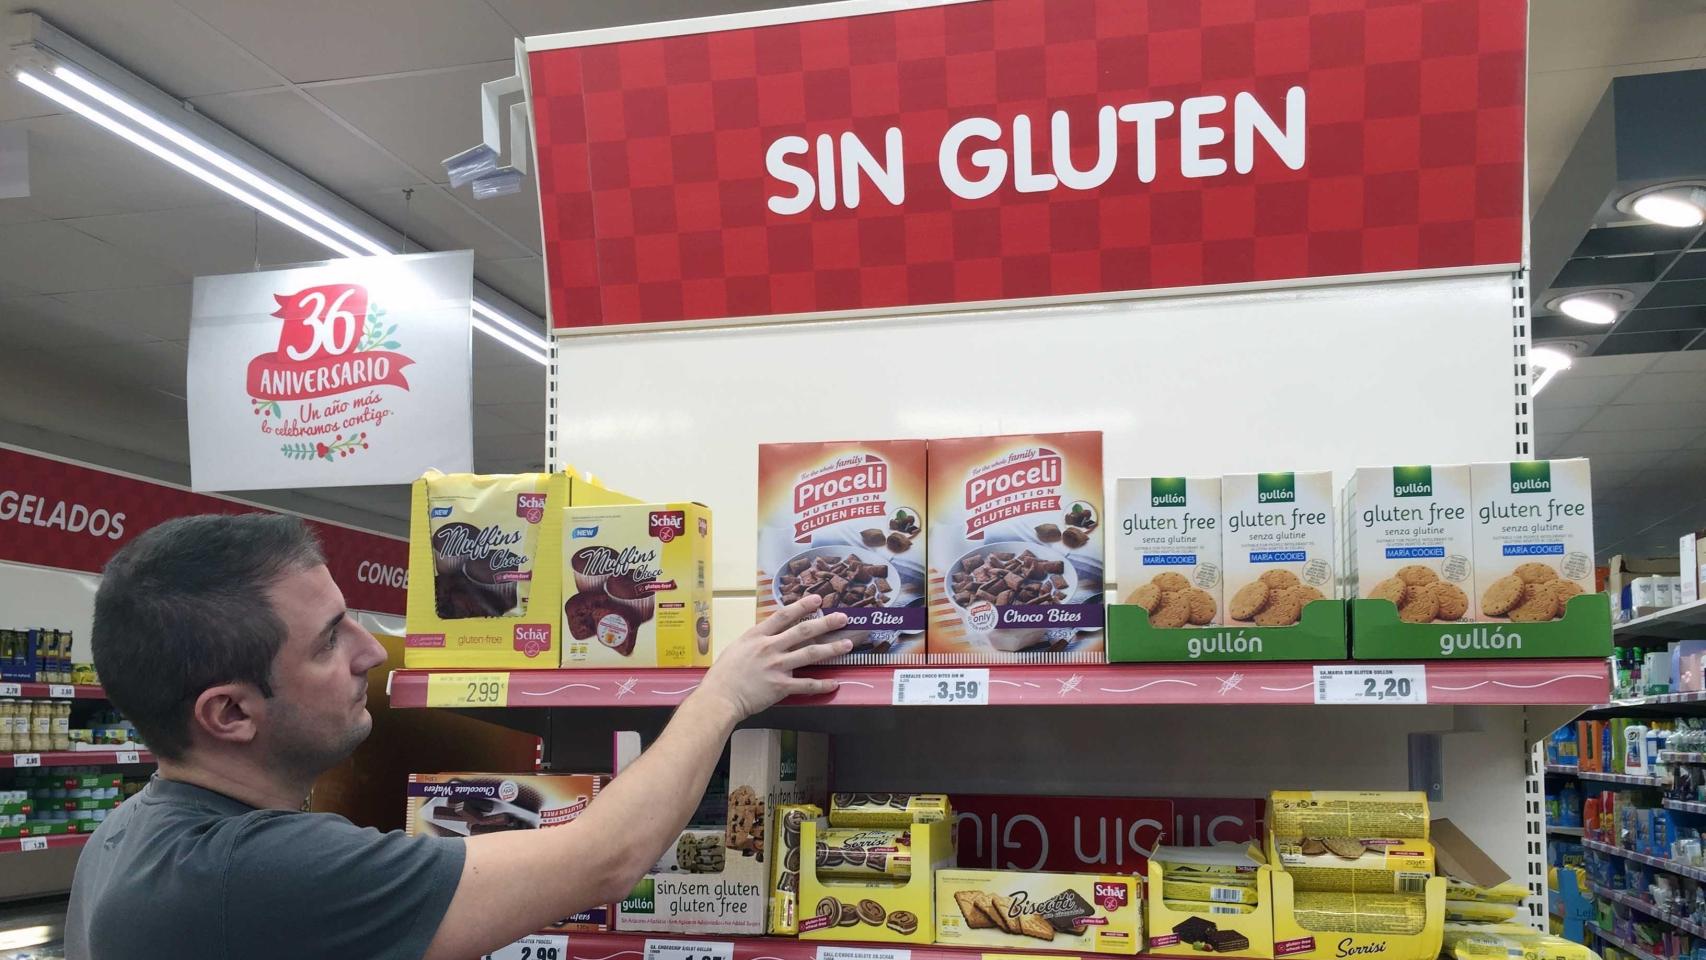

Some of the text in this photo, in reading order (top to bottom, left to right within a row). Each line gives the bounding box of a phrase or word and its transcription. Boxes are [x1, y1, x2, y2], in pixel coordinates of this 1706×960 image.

[765, 86, 1306, 215] SIN GLUTEN
[286, 288, 356, 361] 36
[260, 356, 390, 396] ANIVERSARIO
[300, 390, 382, 423] Un año más
[261, 406, 394, 437] lo celebramos contigo.
[836, 455, 863, 470] family
[1008, 448, 1036, 464] family
[799, 465, 882, 508] Proceli
[970, 459, 1057, 504] Proceli
[1395, 482, 1431, 496] gullón
[1512, 478, 1550, 493] gullón
[974, 488, 1054, 514] NUTRITION
[1152, 494, 1185, 507] gullón
[1260, 488, 1294, 502] gullón
[802, 494, 880, 518] NUTRITION
[973, 499, 1055, 528] GLUTEN FREE
[1363, 502, 1465, 528] gluten free
[1479, 499, 1585, 524] gluten free
[801, 504, 880, 532] GLUTEN FREE
[1122, 512, 1216, 535] gluten free
[1229, 508, 1326, 532] gluten free
[1502, 523, 1564, 534] senza glutine
[577, 529, 594, 537] NEW
[1168, 534, 1197, 545] glutine
[1249, 531, 1306, 542] senza glutine
[1385, 526, 1444, 537] senza glutine
[438, 525, 521, 560] Muffins
[1411, 547, 1444, 557] COOKIES
[1530, 544, 1563, 554] COOKIES
[490, 548, 529, 571] Choco
[580, 545, 656, 577] Muffins
[1167, 555, 1196, 564] COOKIES
[1274, 551, 1306, 561] COOKIES
[632, 564, 664, 582] Choco
[847, 611, 904, 625] oco Bites
[973, 613, 991, 624] only
[1003, 607, 1082, 623] Choco Bites
[458, 635, 503, 646] gluten-free
[1187, 630, 1263, 658] gullón
[1439, 626, 1522, 655] gullón
[937, 681, 978, 702] 3,59
[1364, 677, 1411, 700] 2,20
[424, 785, 495, 797] Chocolate Wafers
[657, 879, 760, 901] sin/sem gluten
[1095, 884, 1126, 899] Schär
[622, 897, 653, 911] gullón
[670, 896, 748, 917] gluten free
[569, 912, 590, 921] afers
[1336, 937, 1386, 958] Sorrisi
